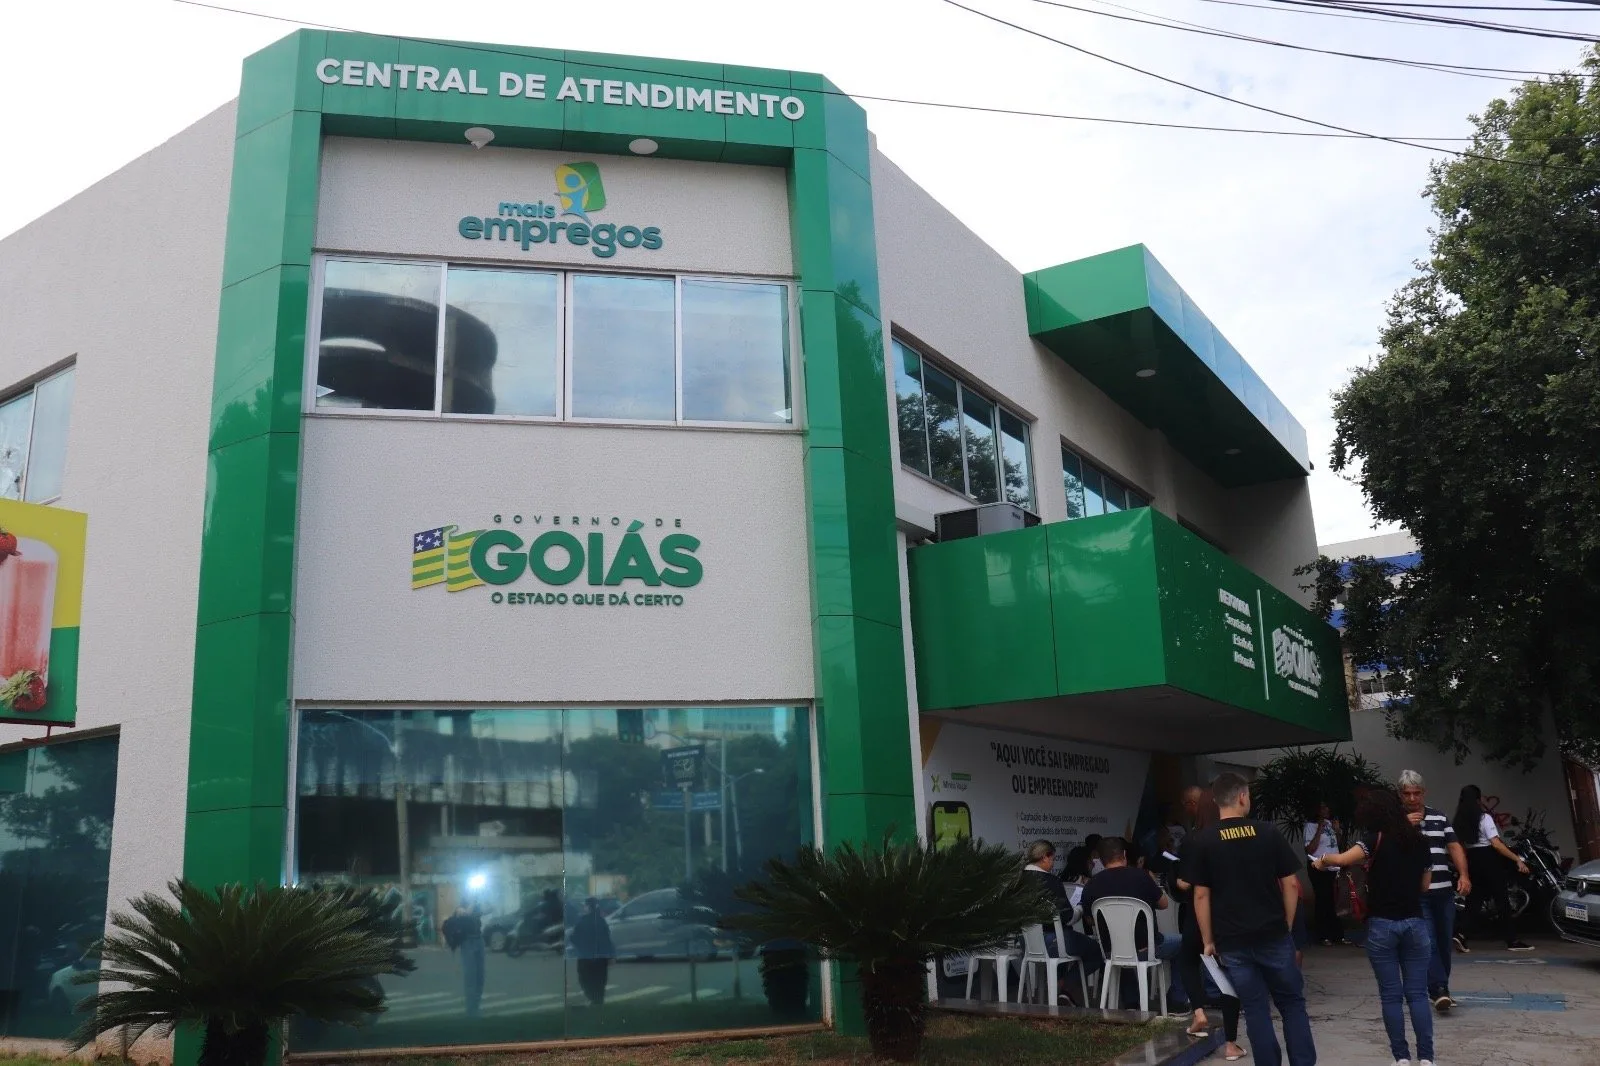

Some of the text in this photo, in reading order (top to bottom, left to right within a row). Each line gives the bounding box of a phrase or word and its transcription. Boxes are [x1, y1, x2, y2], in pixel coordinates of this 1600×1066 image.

[315, 58, 805, 121] CENTRAL DE ATENDIMENTO
[499, 200, 556, 219] mais
[457, 215, 663, 258] empregos
[493, 514, 682, 528] GOVERNO DE
[470, 520, 703, 588] GOIÁS
[491, 591, 684, 606] O ESTADO QUE DÁ CERTO
[1022, 745, 1047, 768] VOCÊ
[1048, 750, 1062, 768] SAI
[1063, 752, 1110, 774] EMPREGADO
[1012, 774, 1026, 794] OU
[1220, 825, 1256, 840] NIRVANA
